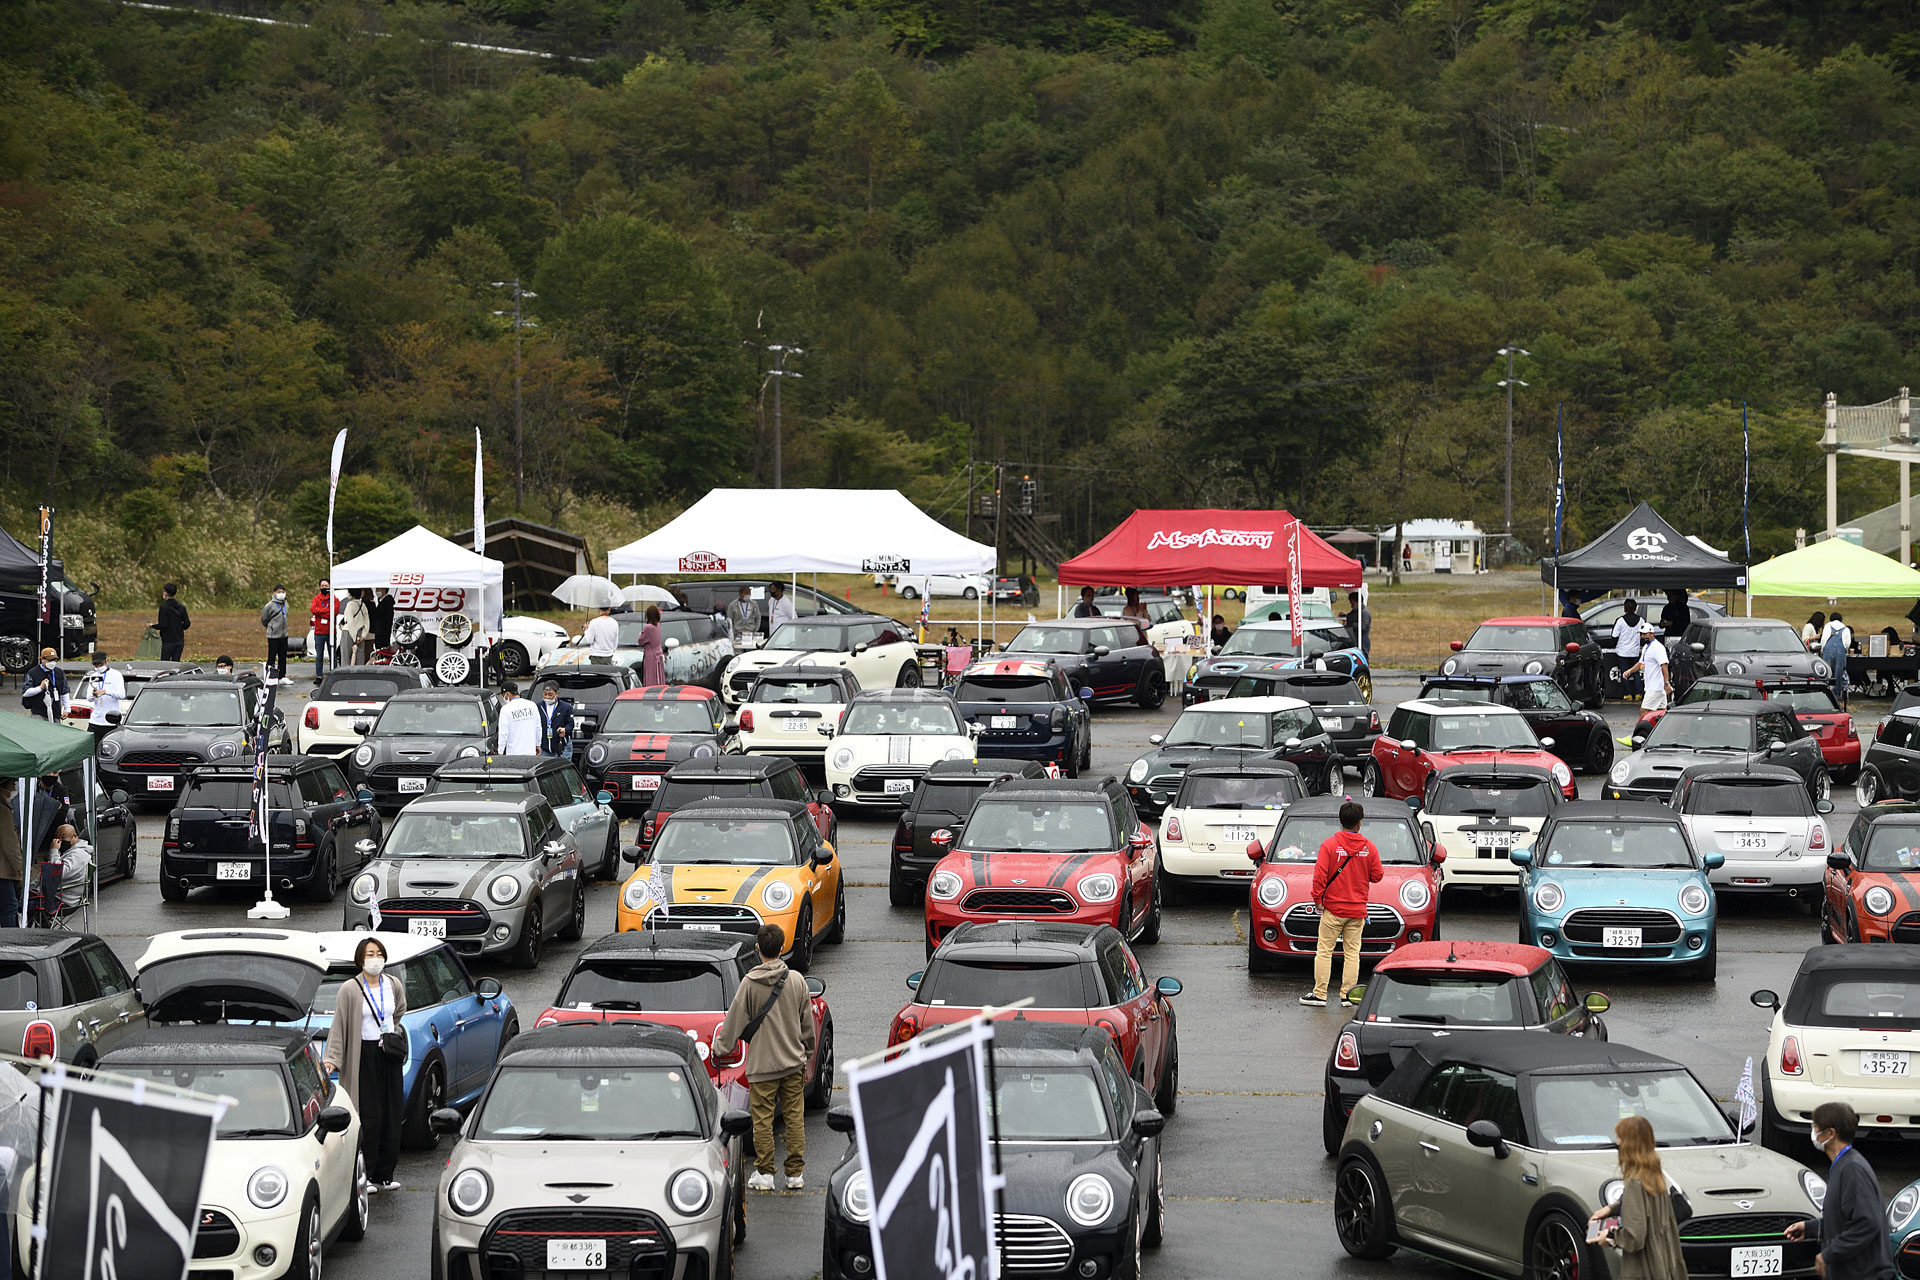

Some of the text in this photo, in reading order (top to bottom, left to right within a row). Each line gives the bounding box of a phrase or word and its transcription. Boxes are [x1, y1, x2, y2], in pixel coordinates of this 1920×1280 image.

[694, 553, 712, 562] MINI
[878, 554, 895, 562] MINI
[390, 573, 424, 584] BBS
[392, 587, 465, 612] BBS
[1231, 832, 1255, 840] 11-29
[1484, 837, 1509, 846] 32-98
[1741, 839, 1766, 848] 34-53
[225, 869, 249, 878] 32-68
[1612, 936, 1640, 945] 32-57
[1871, 1061, 1907, 1074] 35-27
[1744, 1250, 1772, 1258] 大阪330
[1743, 1258, 1780, 1275] 57-32
